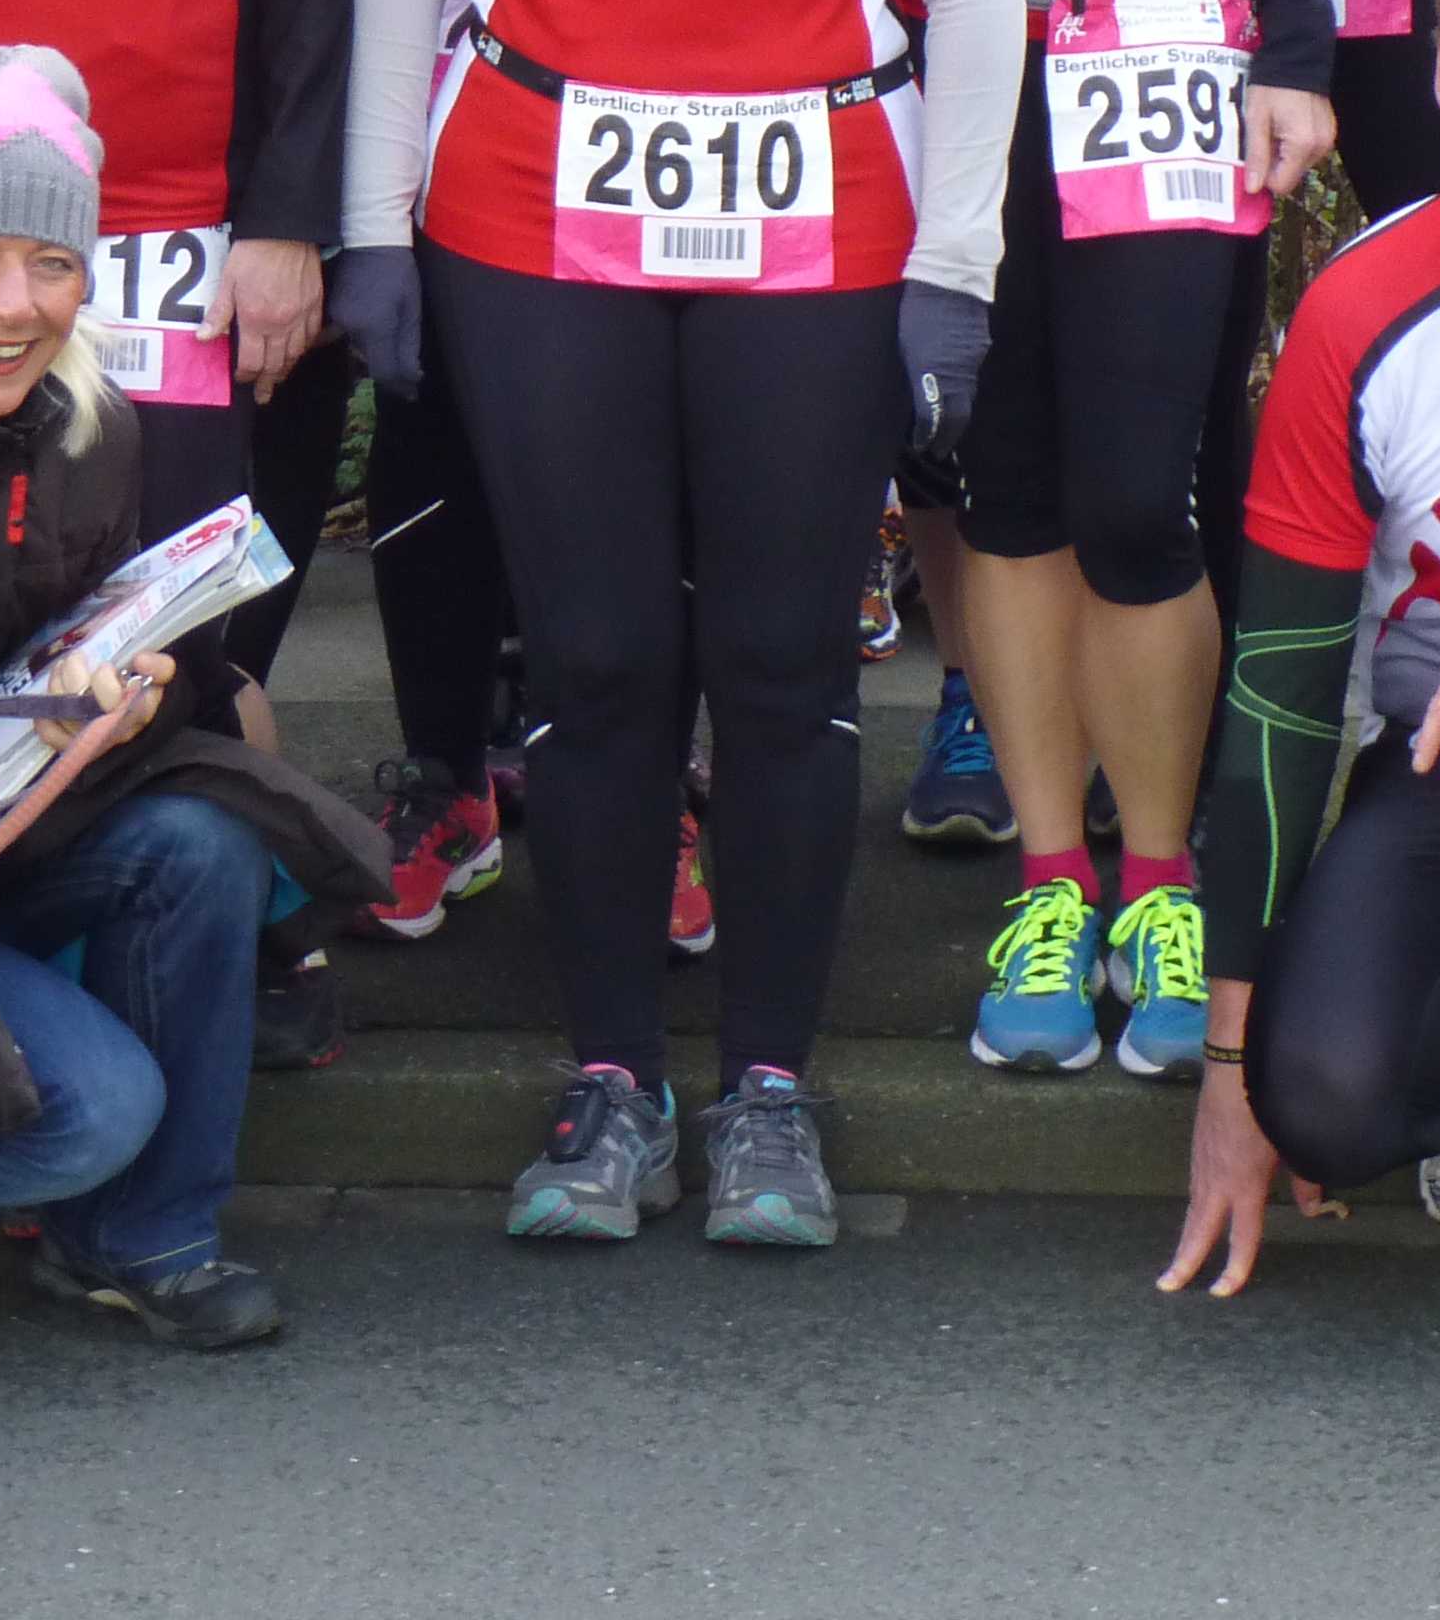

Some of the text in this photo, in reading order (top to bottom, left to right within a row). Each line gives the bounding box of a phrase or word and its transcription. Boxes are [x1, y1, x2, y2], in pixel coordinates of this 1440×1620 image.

[1054, 54, 1158, 74] Bertlicher
[573, 89, 821, 117] Bertlicher Straßenläufe
[584, 114, 804, 213] 2610
